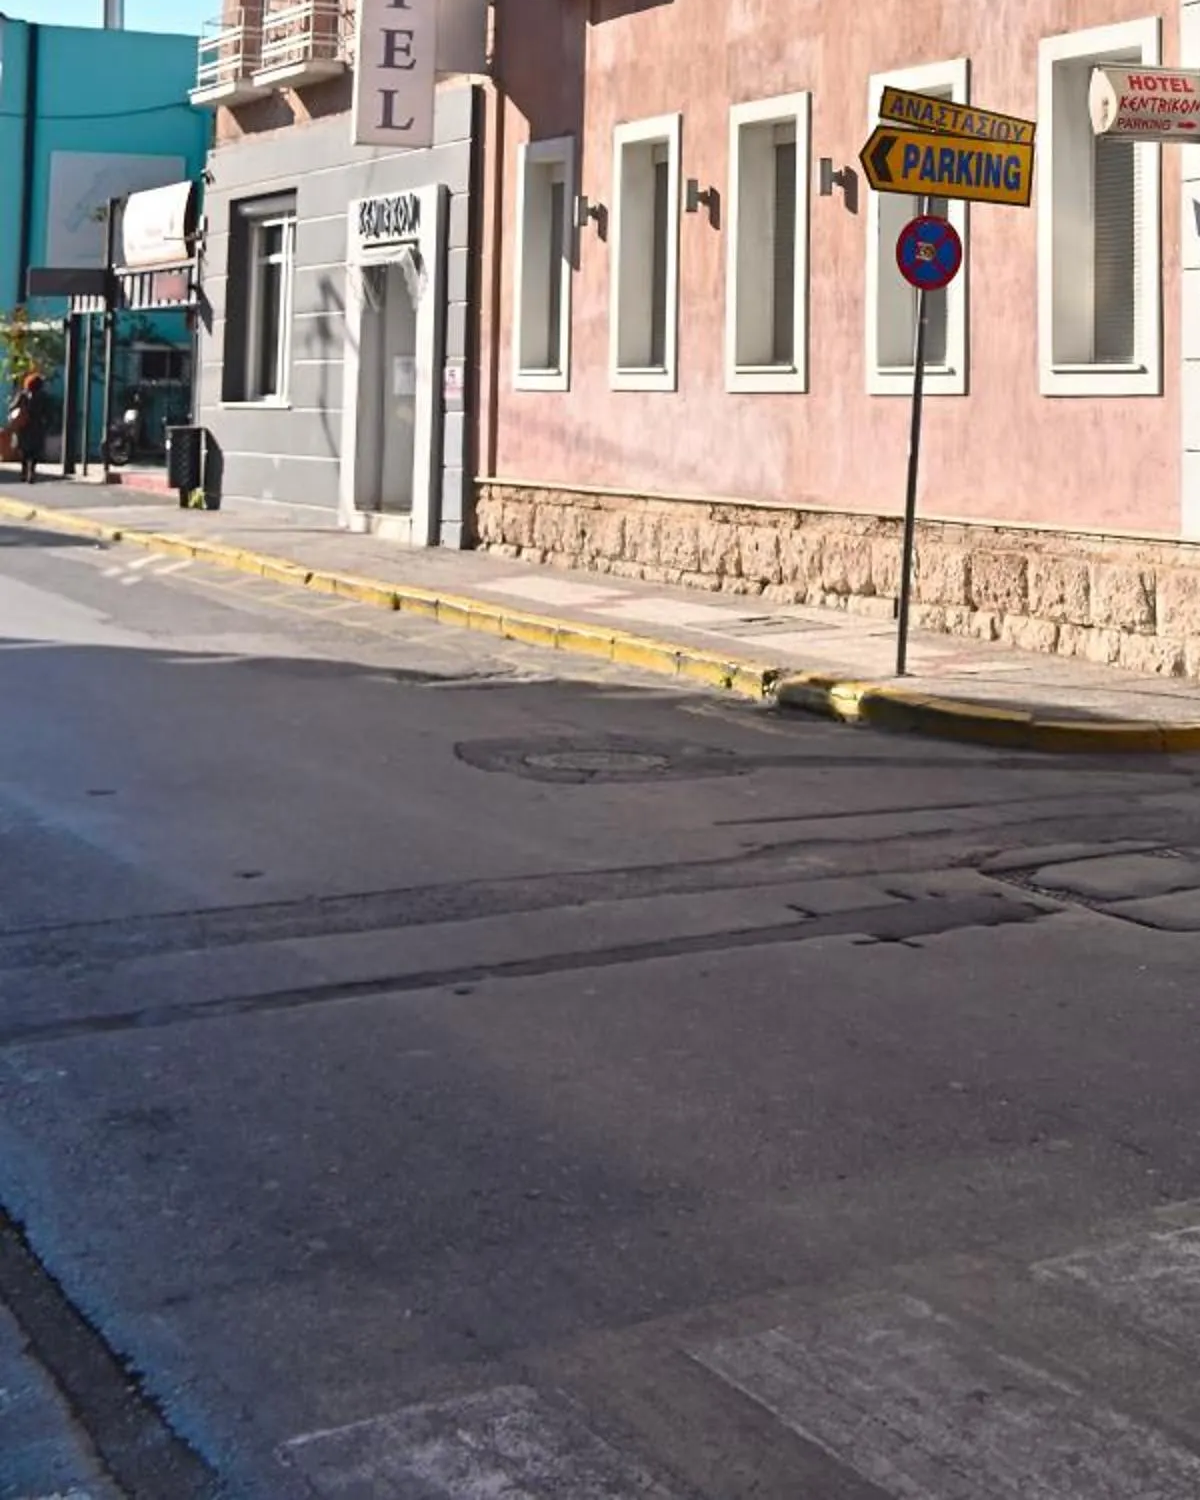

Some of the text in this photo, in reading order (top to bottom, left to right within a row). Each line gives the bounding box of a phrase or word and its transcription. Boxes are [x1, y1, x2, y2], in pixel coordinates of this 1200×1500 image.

[1128, 75, 1194, 92] HOTEL
[889, 98, 1027, 142] ΑΝΑΣΤΑΣΙΟΥ
[1117, 117, 1172, 131] PARKING
[902, 143, 1021, 191] PARKING
